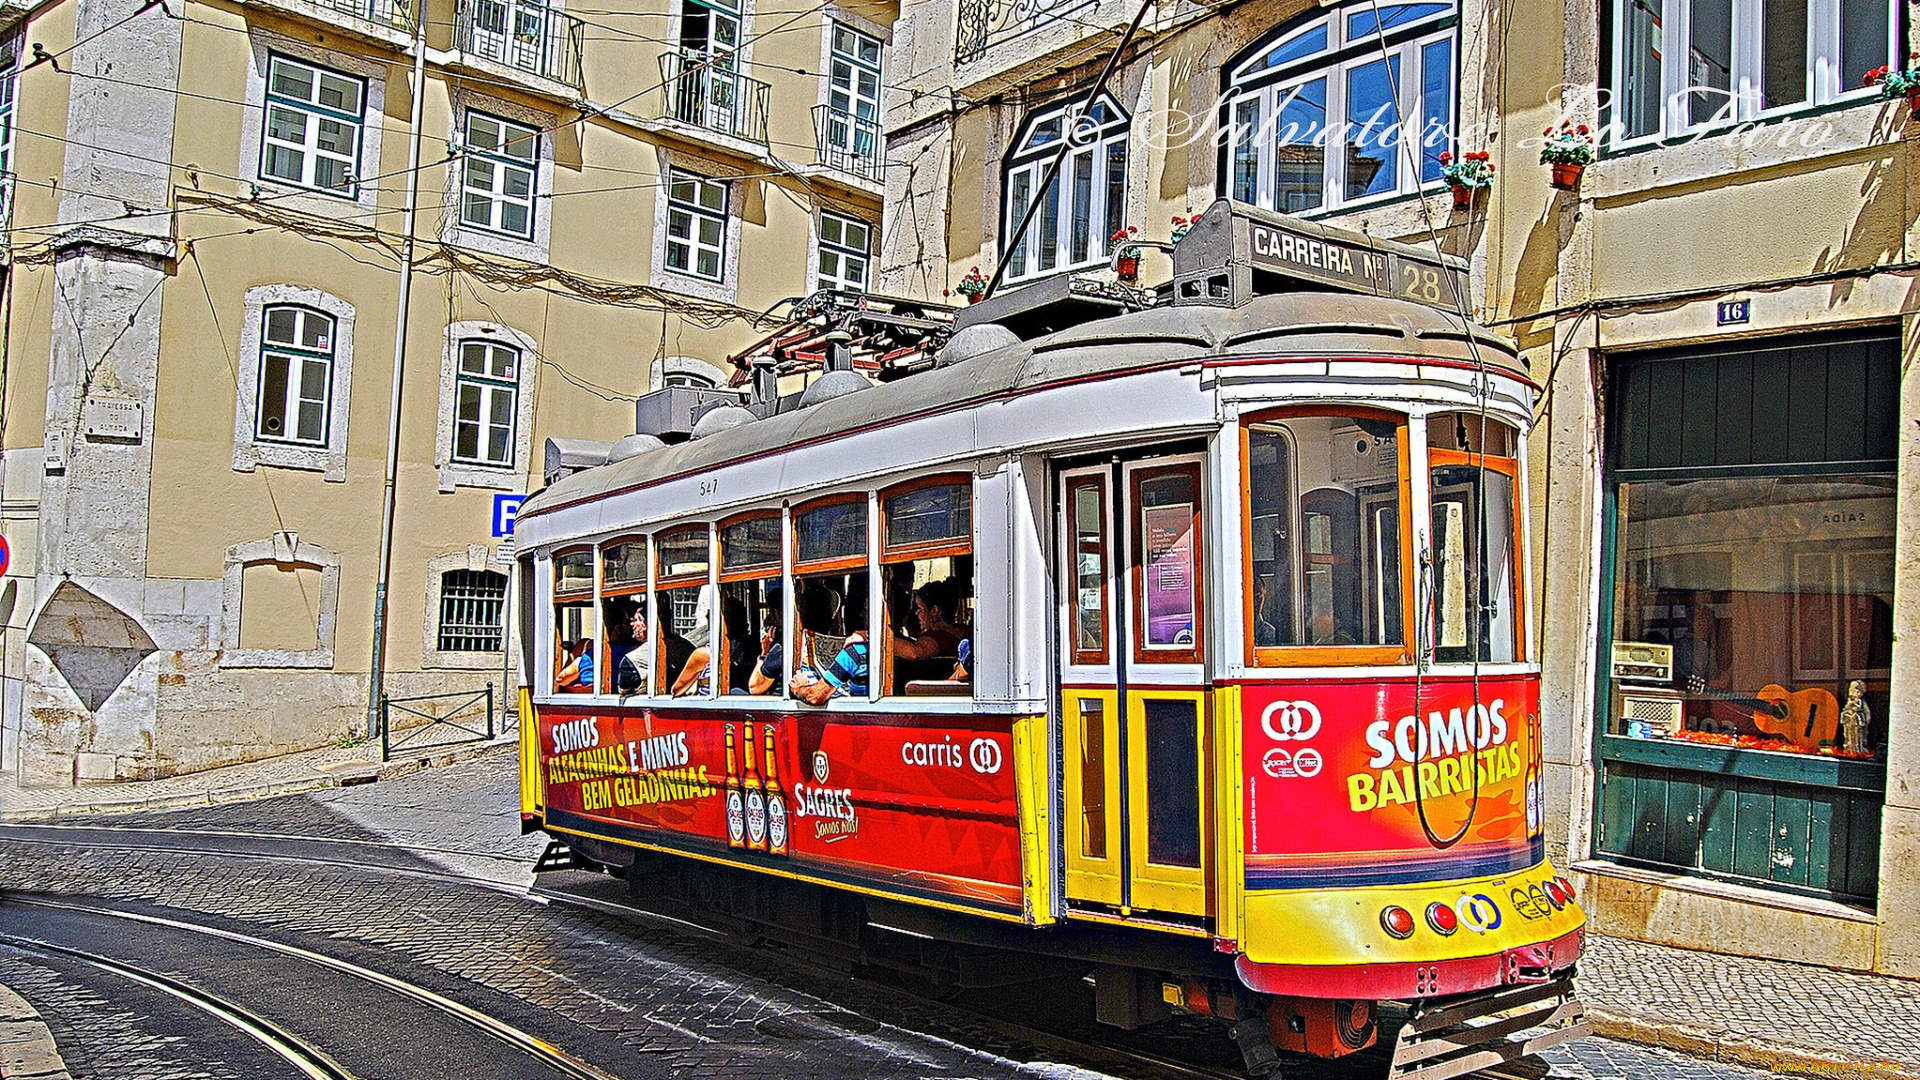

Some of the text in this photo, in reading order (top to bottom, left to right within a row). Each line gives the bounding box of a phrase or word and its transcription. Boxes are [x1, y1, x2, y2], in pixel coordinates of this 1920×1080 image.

[1254, 227, 1354, 276] CARREIRA
[1403, 264, 1440, 304] 28
[1723, 303, 1743, 320] 16
[700, 478, 718, 496] 547
[500, 499, 521, 533] P
[552, 716, 600, 754] SOMOS
[902, 734, 963, 768] carris
[1365, 698, 1508, 769] SOMOS
[549, 731, 690, 785] ALFACINHAS E MINIS
[1347, 740, 1521, 812] BAIRRISTAS
[582, 780, 613, 811] BEM
[795, 782, 855, 820] SAGRES
